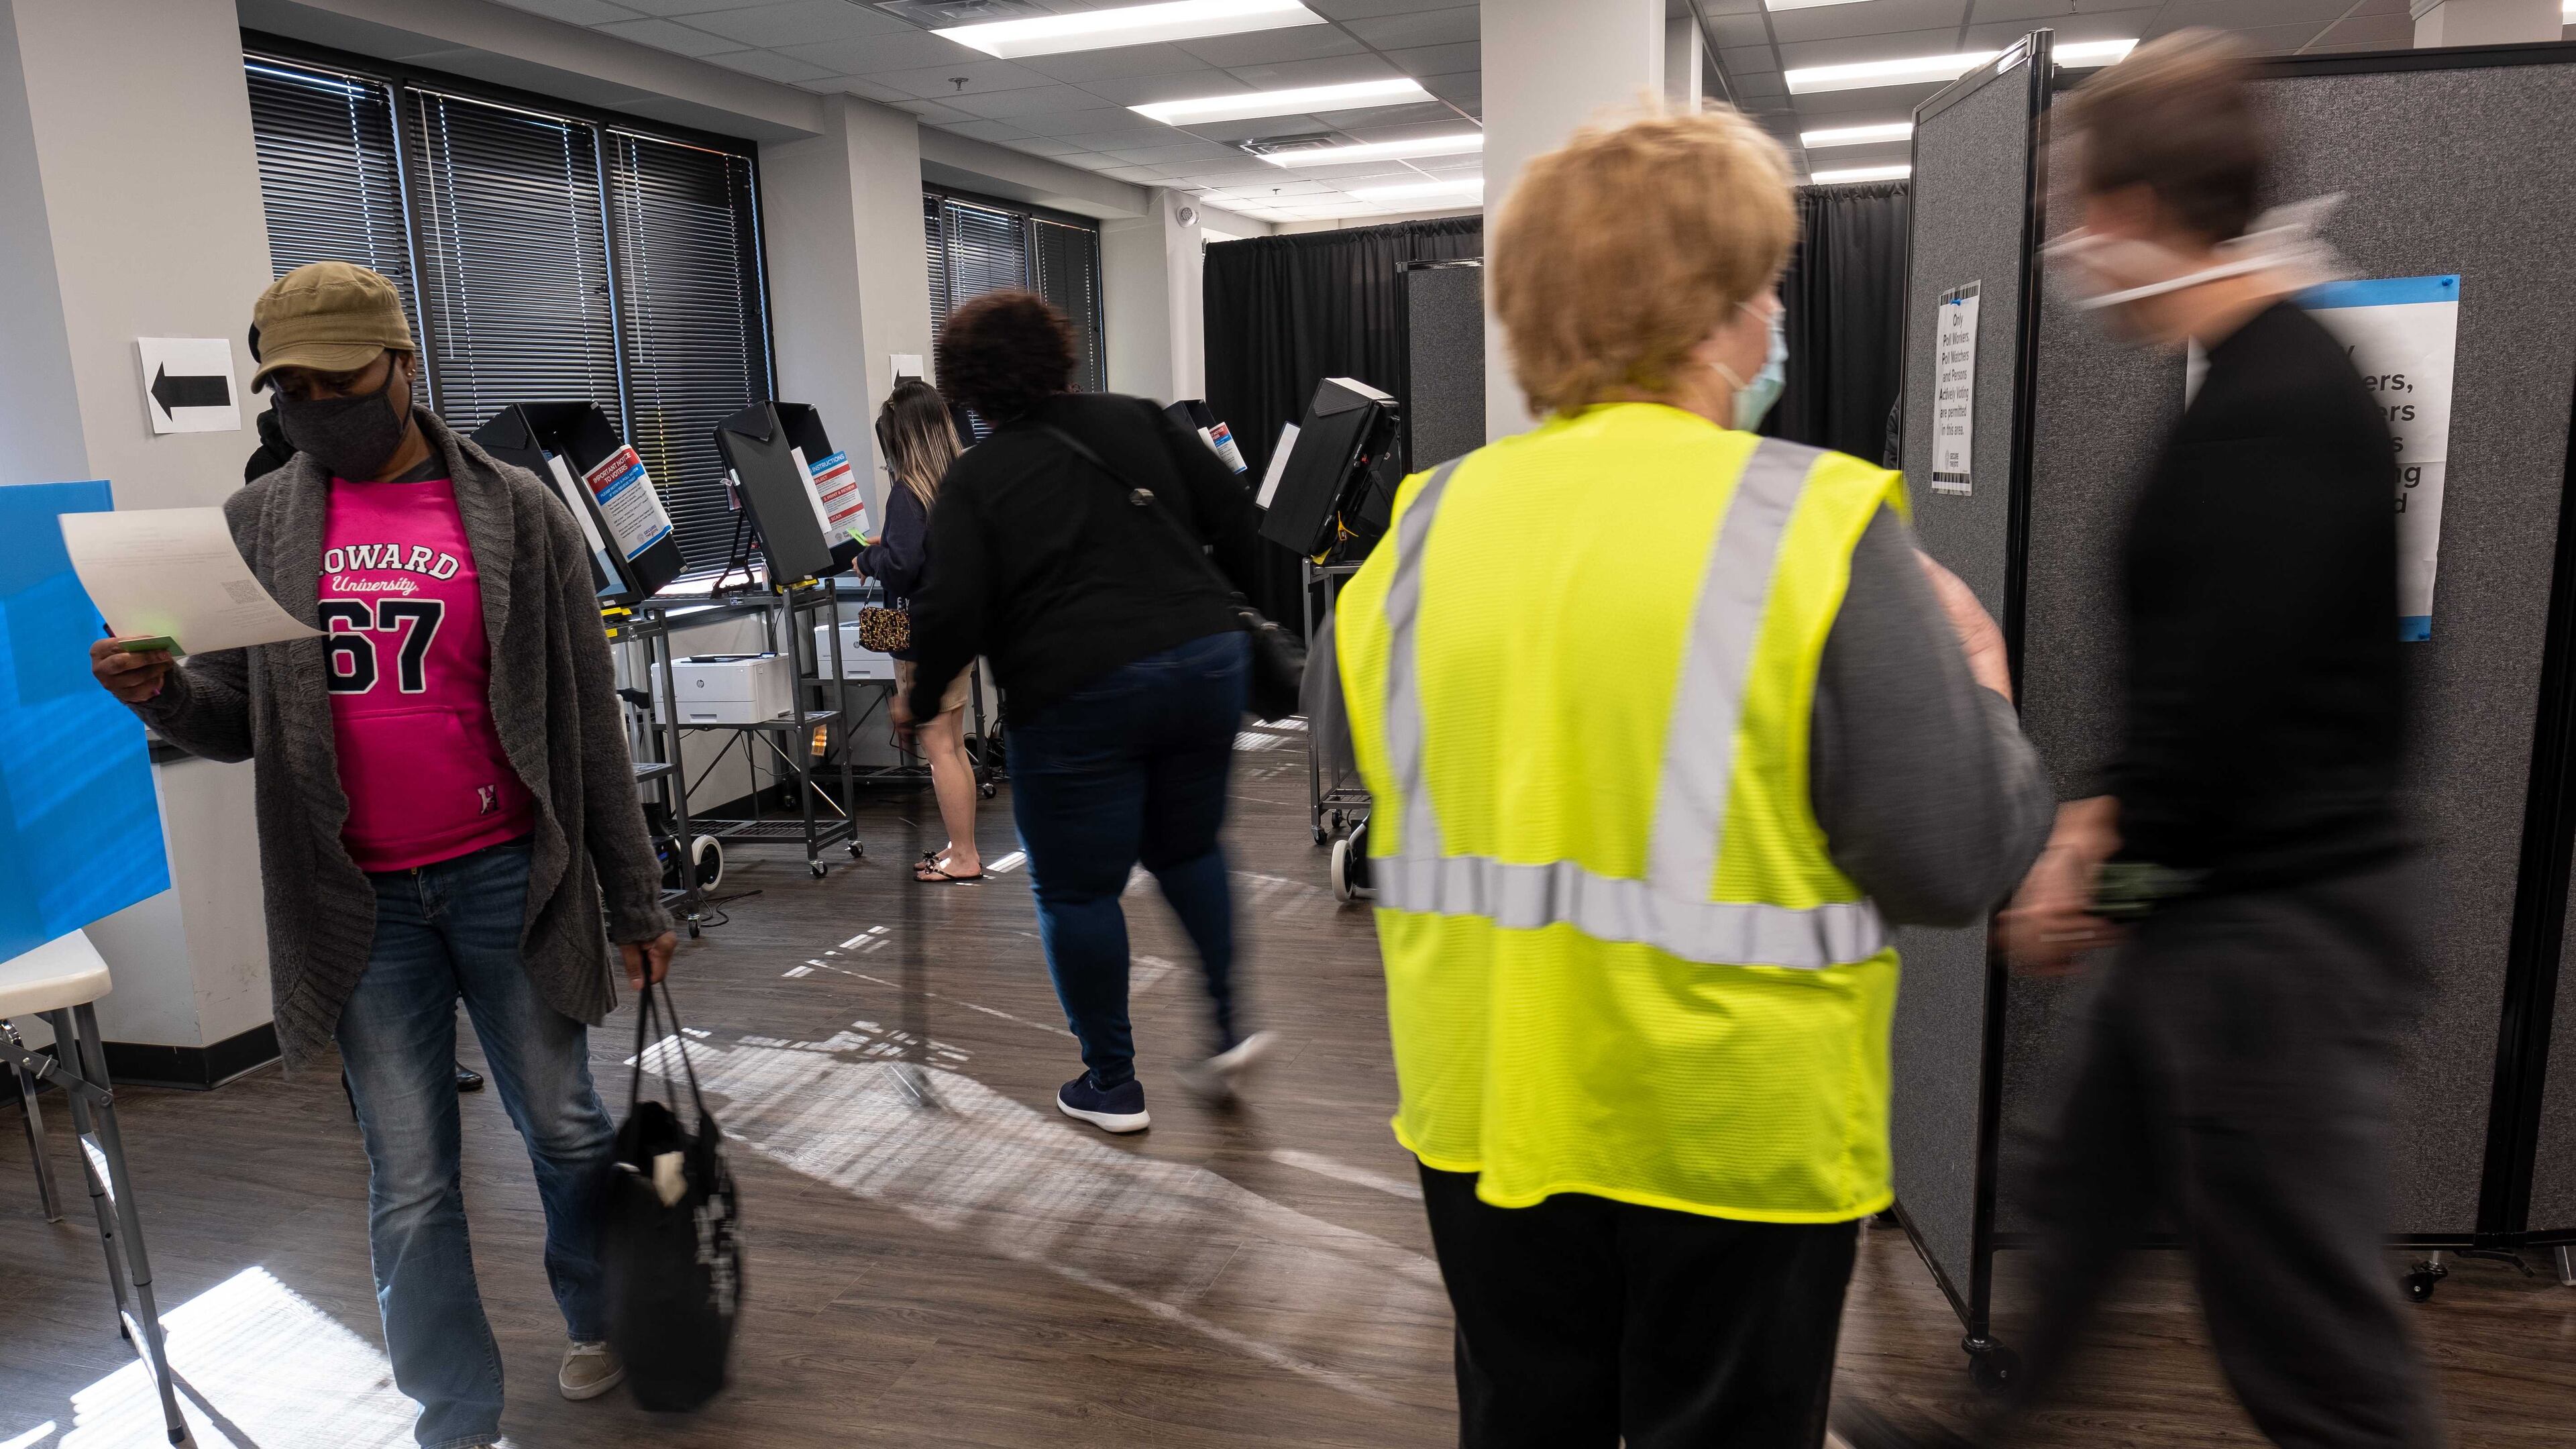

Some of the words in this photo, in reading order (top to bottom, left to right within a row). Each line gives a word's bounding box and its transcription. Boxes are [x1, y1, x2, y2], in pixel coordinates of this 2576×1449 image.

[1953, 313, 1964, 329] Only
[1943, 333, 1951, 347] Poll
[1941, 352, 1951, 365] Poll
[1951, 349, 1969, 364] Watchers
[1943, 370, 1951, 382] and
[1951, 368, 1967, 381] Persons
[812, 453, 845, 472] INSTRUCTIONS
[592, 463, 618, 484] IMPORTANT
[604, 476, 612, 484] TO
[610, 464, 628, 479] VOTERS
[319, 543, 460, 581] OWARD
[332, 575, 417, 596] University
[318, 598, 445, 694] 67
